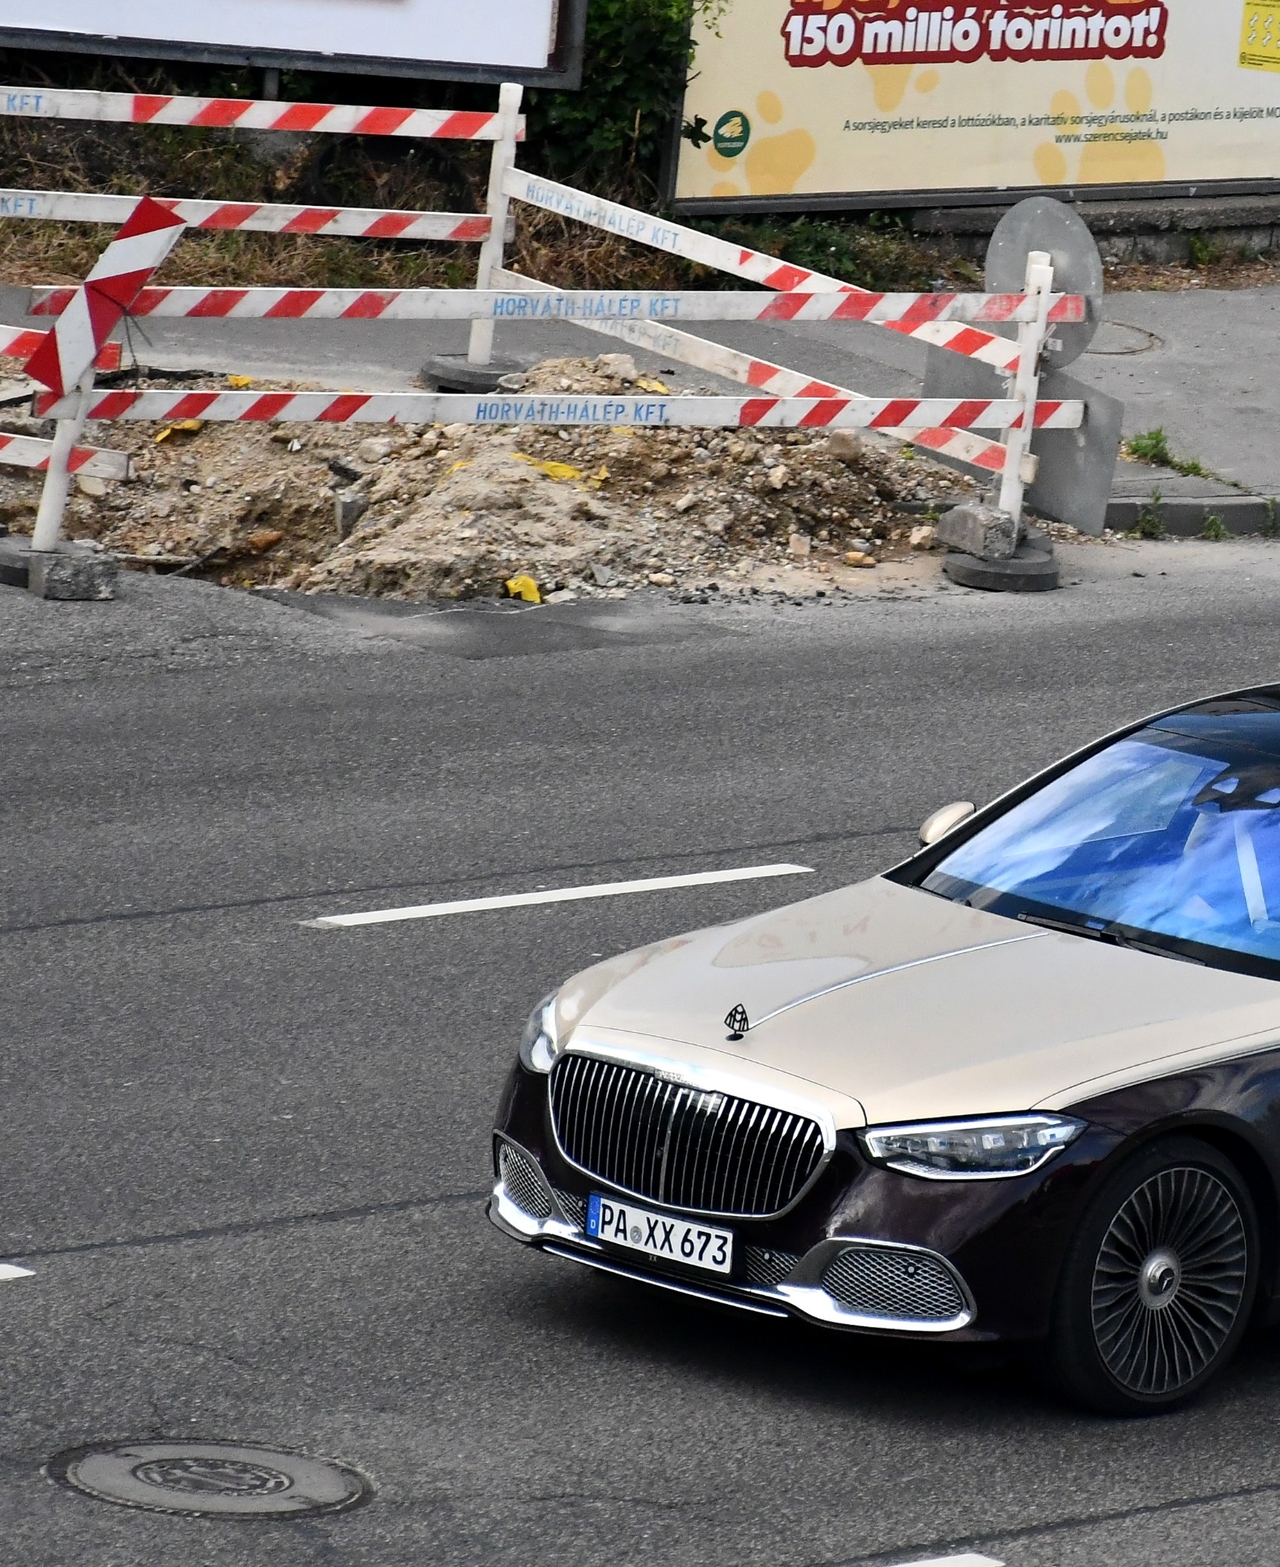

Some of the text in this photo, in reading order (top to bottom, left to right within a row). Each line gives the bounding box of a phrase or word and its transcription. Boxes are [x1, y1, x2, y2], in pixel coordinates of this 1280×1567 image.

[785, 4, 1161, 56] 150 millió forintot!
[843, 119, 852, 131] A
[852, 116, 914, 134] sorsjegyeket
[915, 116, 949, 130] keresd
[950, 118, 956, 128] a
[1020, 115, 1027, 127] a
[1160, 112, 1167, 122] a
[1168, 107, 1212, 124] postákon
[1213, 106, 1223, 120] és
[1225, 109, 1232, 120] a
[525, 184, 680, 248] HORVÁTH-HÁLÉP KFT
[493, 295, 681, 318] HORVÁTH-HÁLÉP KFT
[475, 400, 667, 422] HORVÁTH-HÁLÉP KFT
[600, 1203, 728, 1266] PA XX 673
